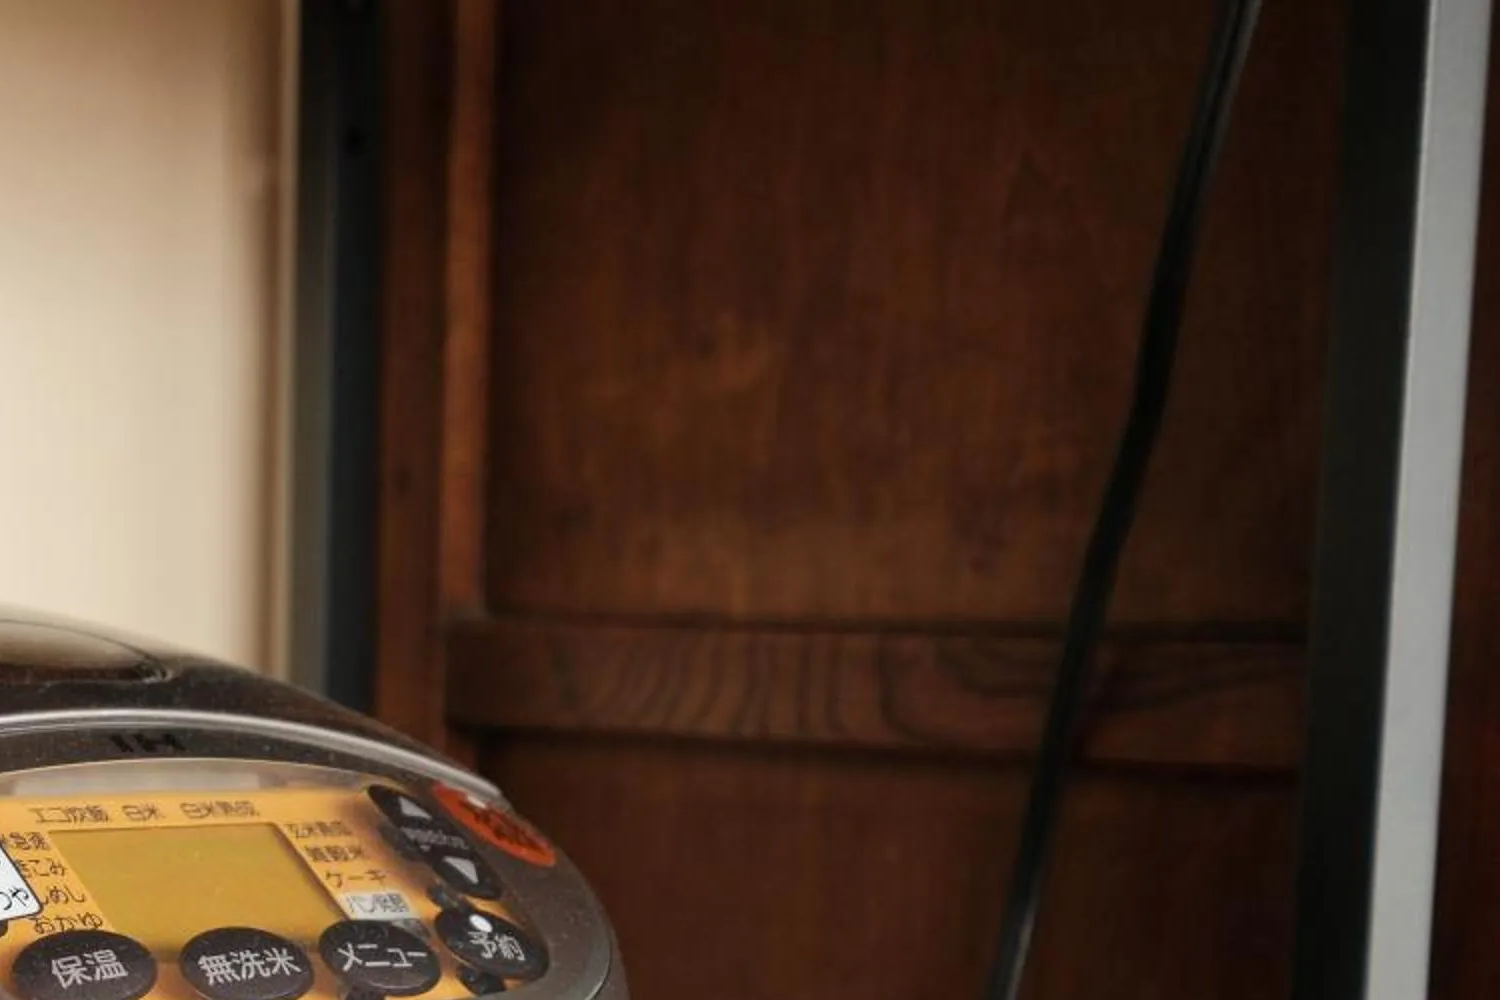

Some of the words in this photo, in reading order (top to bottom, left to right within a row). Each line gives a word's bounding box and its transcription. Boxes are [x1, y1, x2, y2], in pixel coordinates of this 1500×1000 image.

[325, 868, 388, 889] ケーキ
[50, 948, 129, 989] 保温
[198, 946, 301, 986] 無洗米
[336, 943, 428, 971] メニュー
